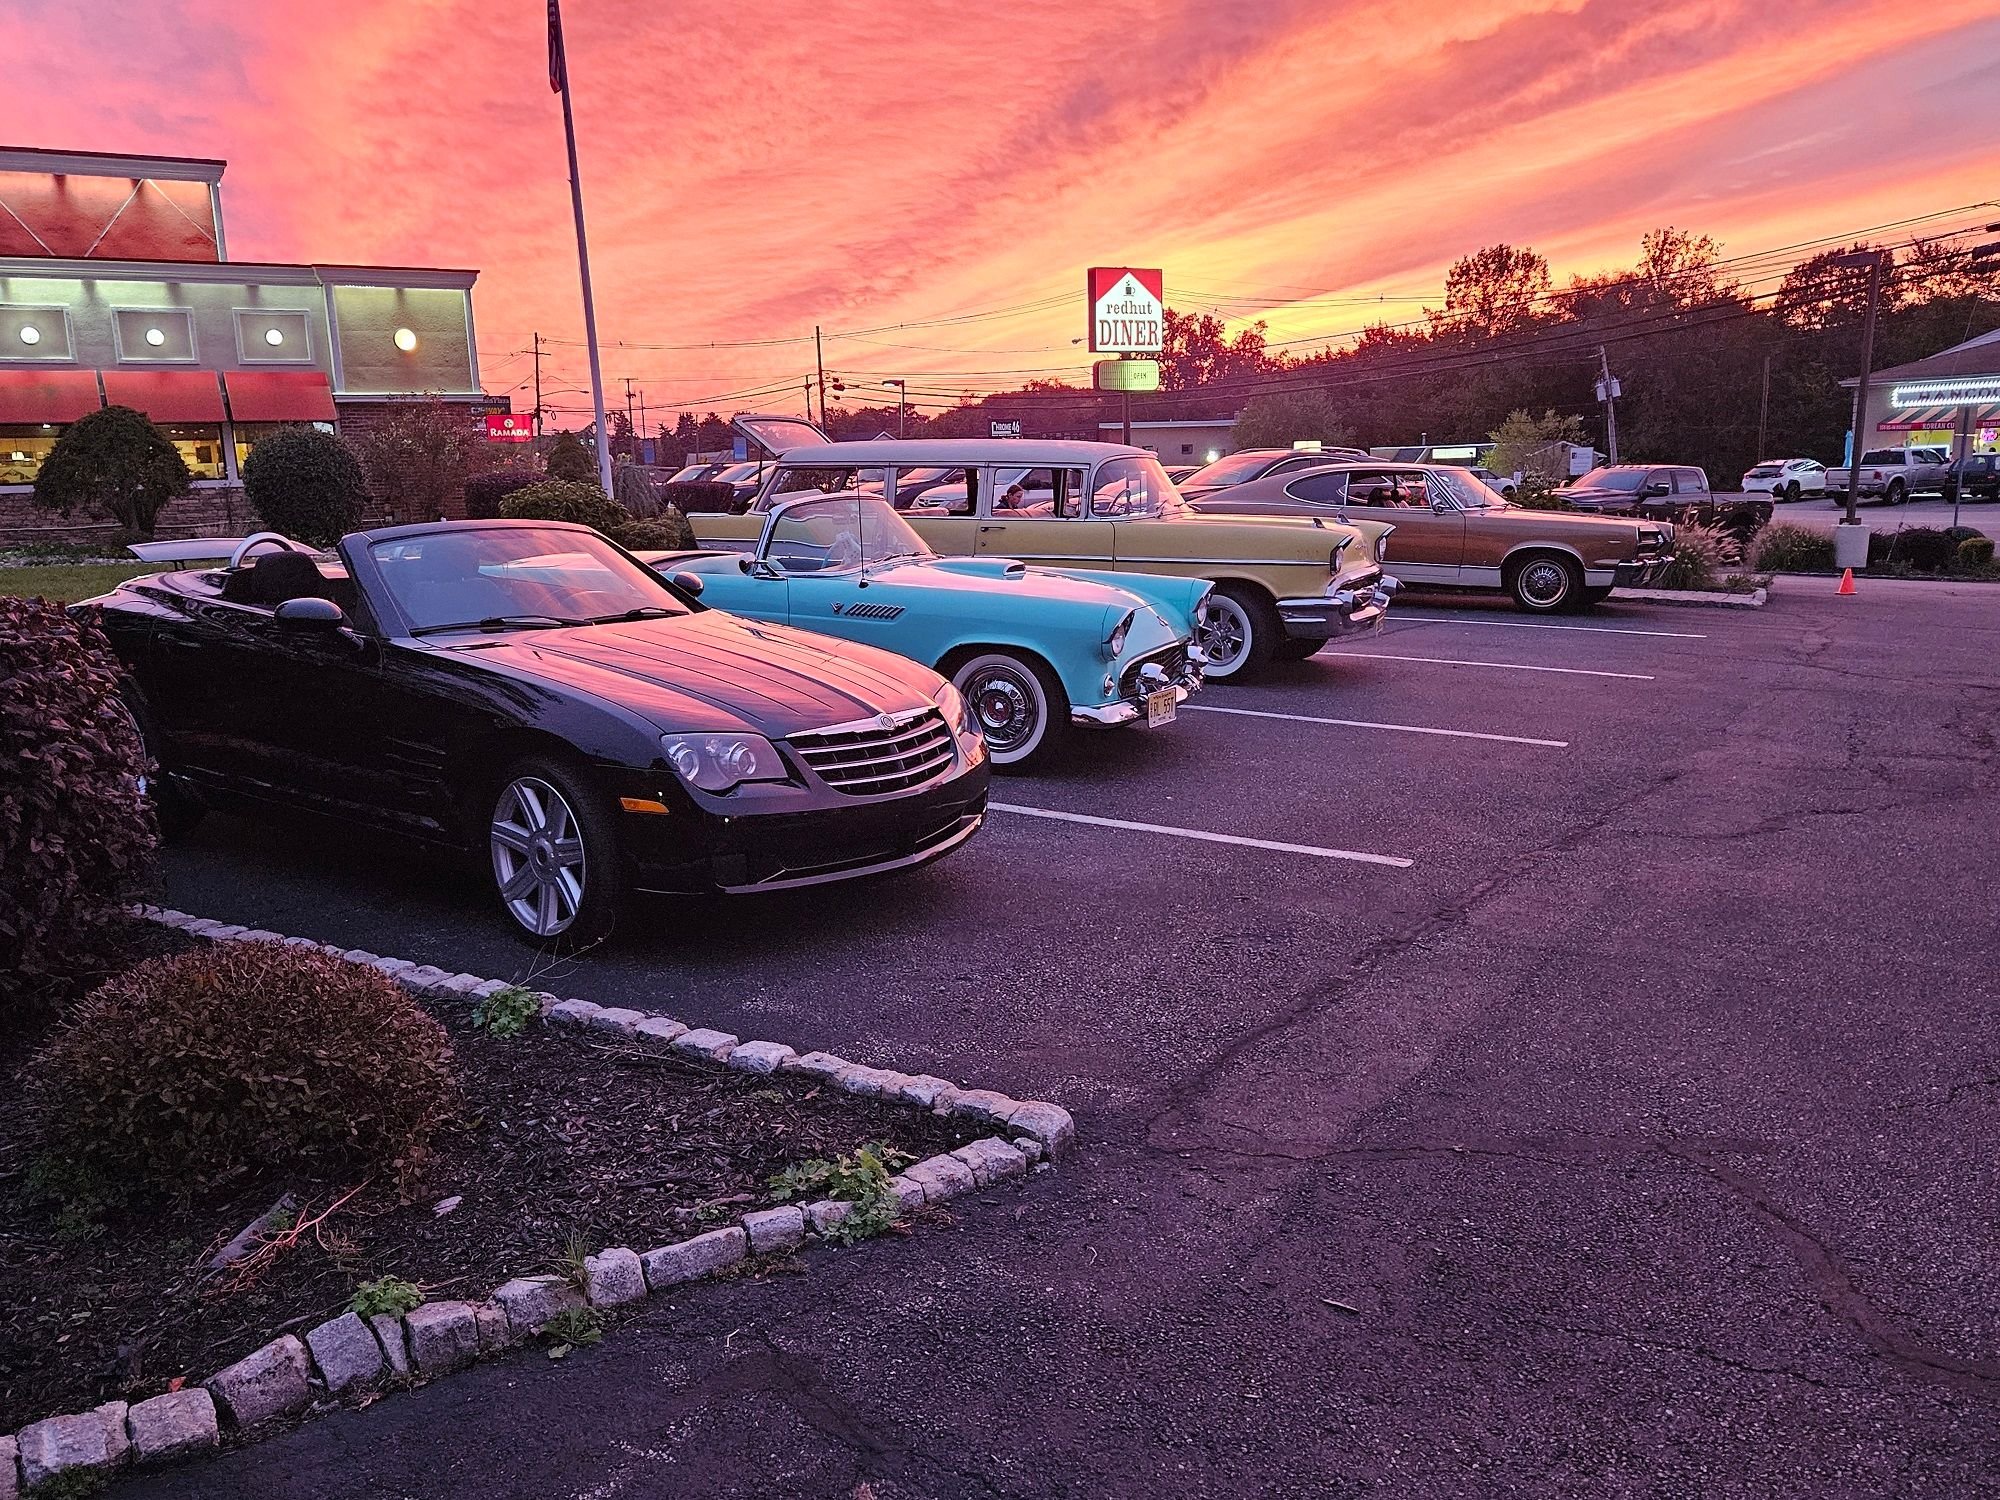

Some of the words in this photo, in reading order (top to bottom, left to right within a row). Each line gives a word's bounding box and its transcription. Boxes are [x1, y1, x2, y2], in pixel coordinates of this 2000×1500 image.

[1106, 301, 1153, 315] redhut
[1099, 319, 1160, 346] DINER
[490, 427, 530, 437] RAMADA
[1012, 420, 1020, 433] 46
